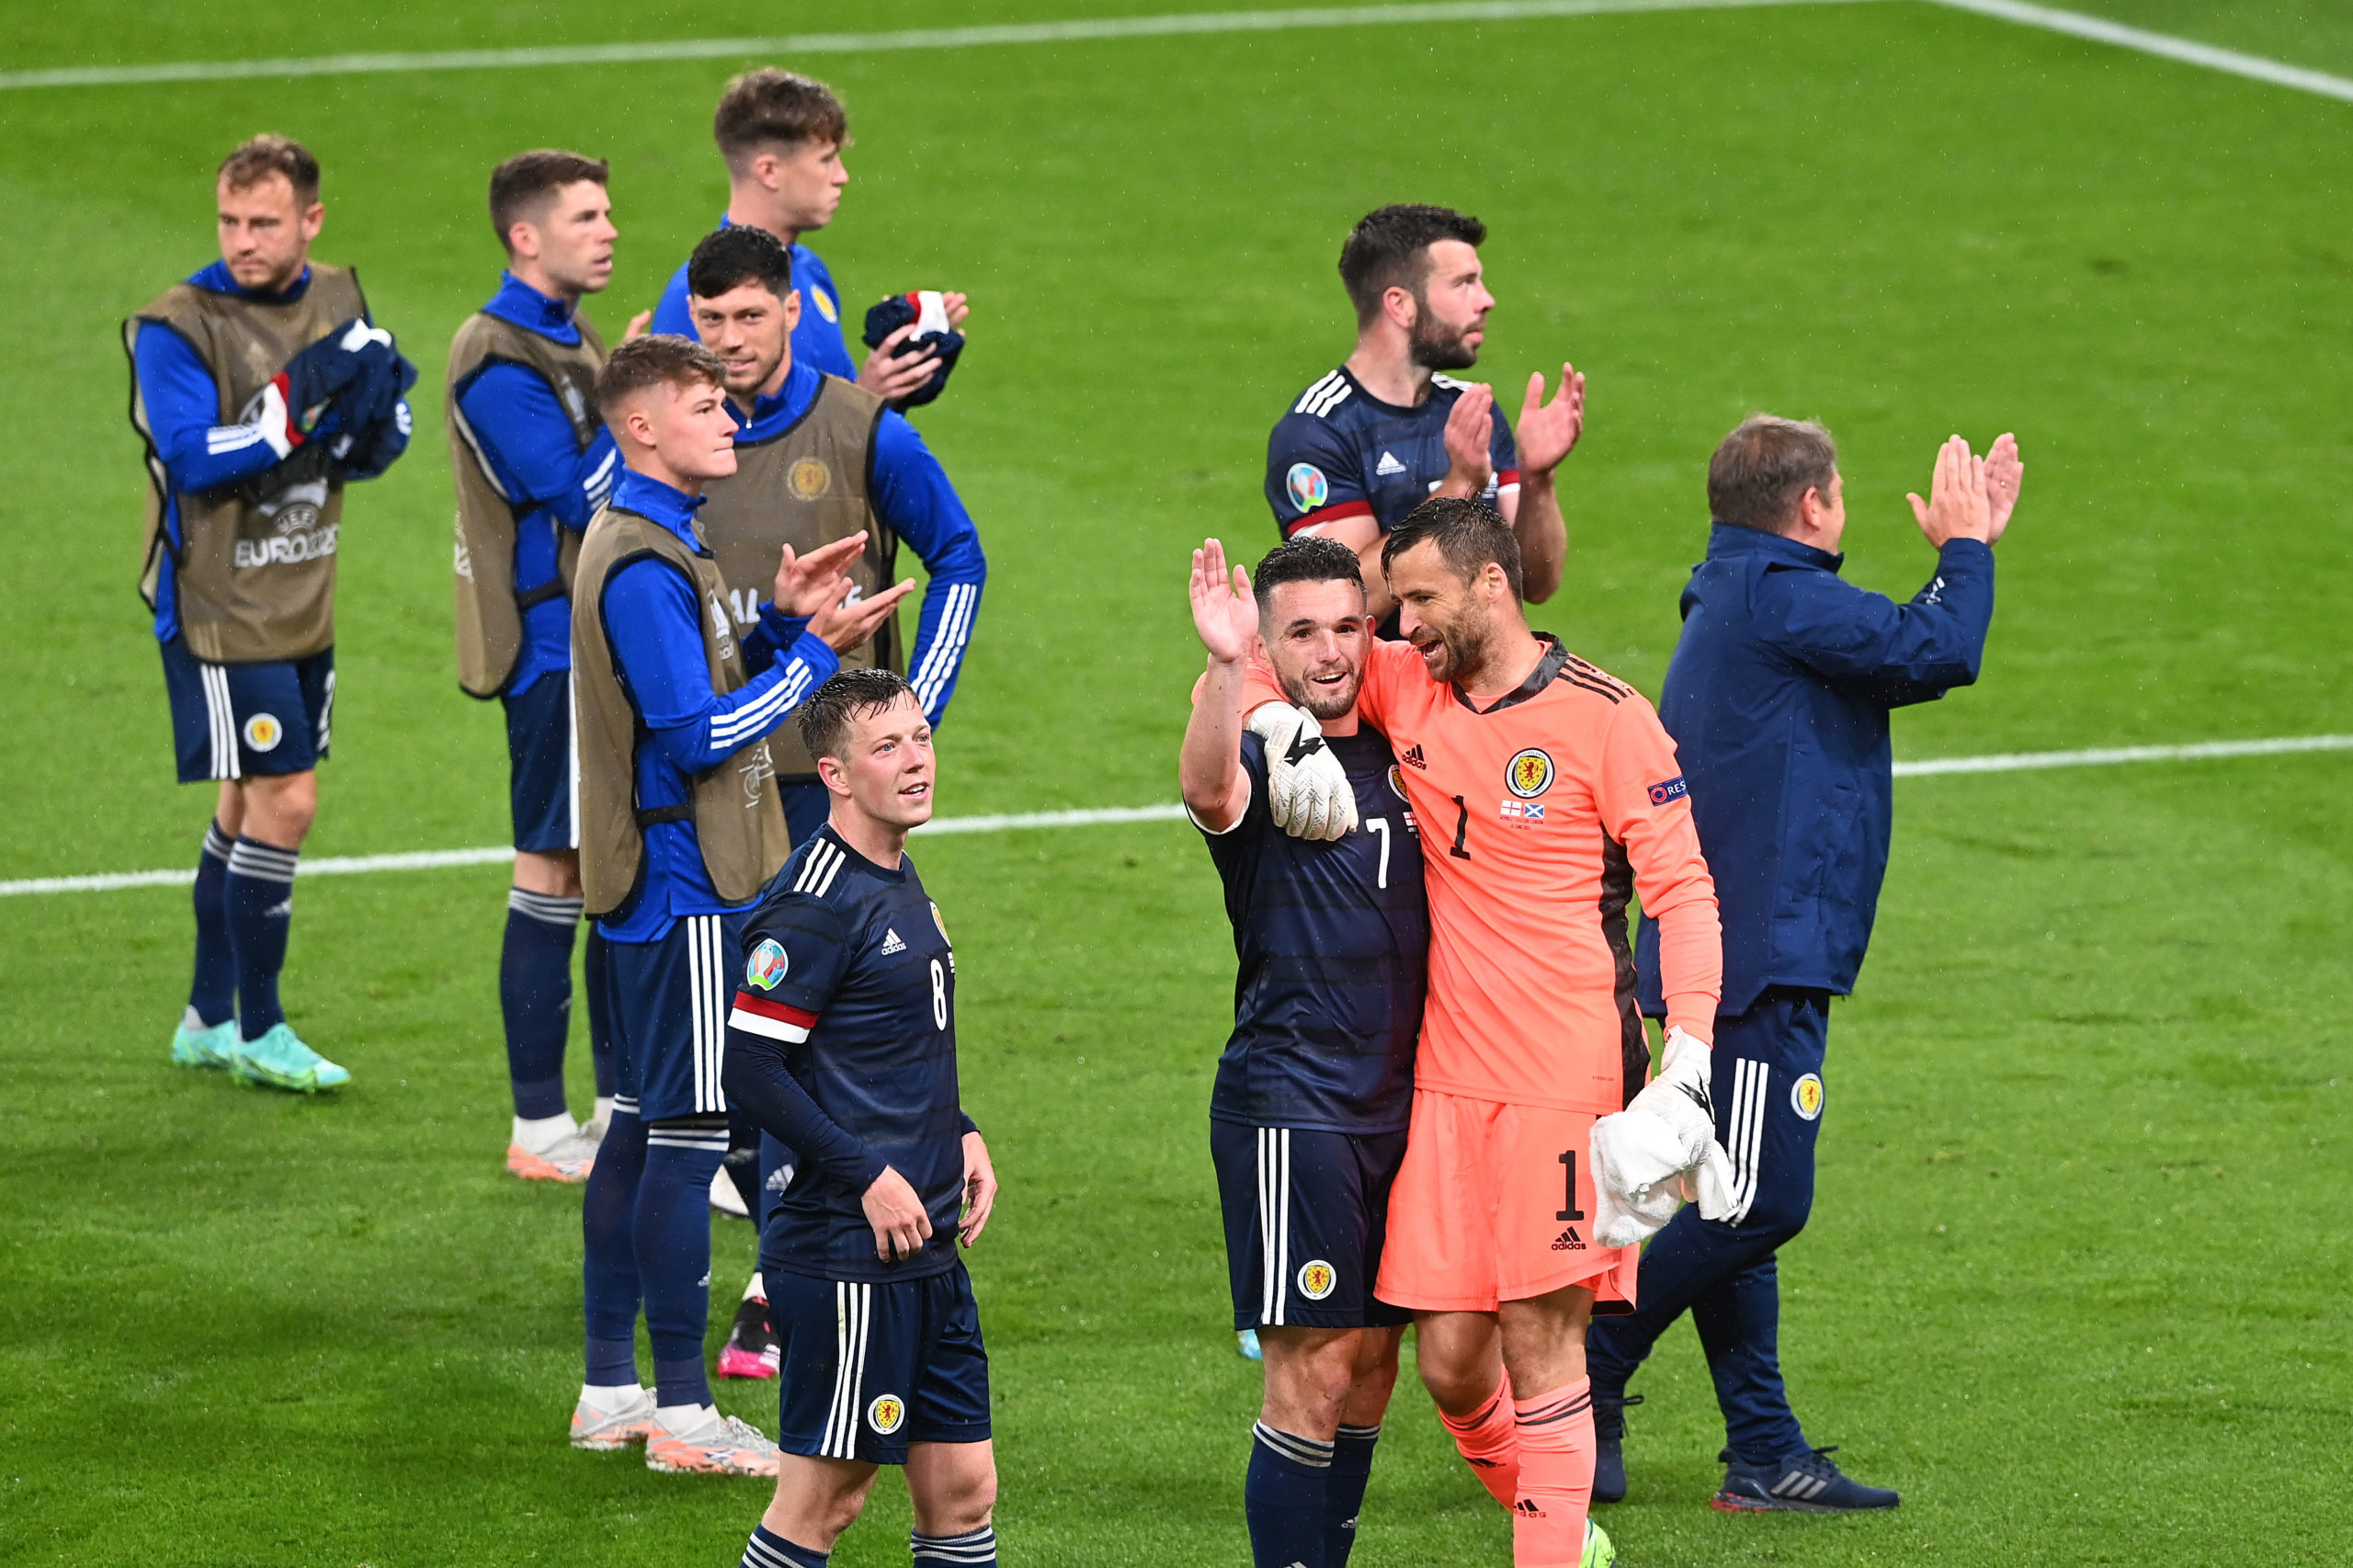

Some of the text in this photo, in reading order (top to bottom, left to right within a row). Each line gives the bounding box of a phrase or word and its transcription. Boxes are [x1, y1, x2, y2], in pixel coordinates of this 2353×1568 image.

[1402, 755, 1427, 770] adidas
[1366, 818, 1390, 889] 7
[1449, 795, 1471, 860] 1
[881, 942, 906, 956] adidas
[930, 959, 947, 1030] 8
[1556, 1150, 1585, 1221] 1
[1552, 1242, 1586, 1251] adidas
